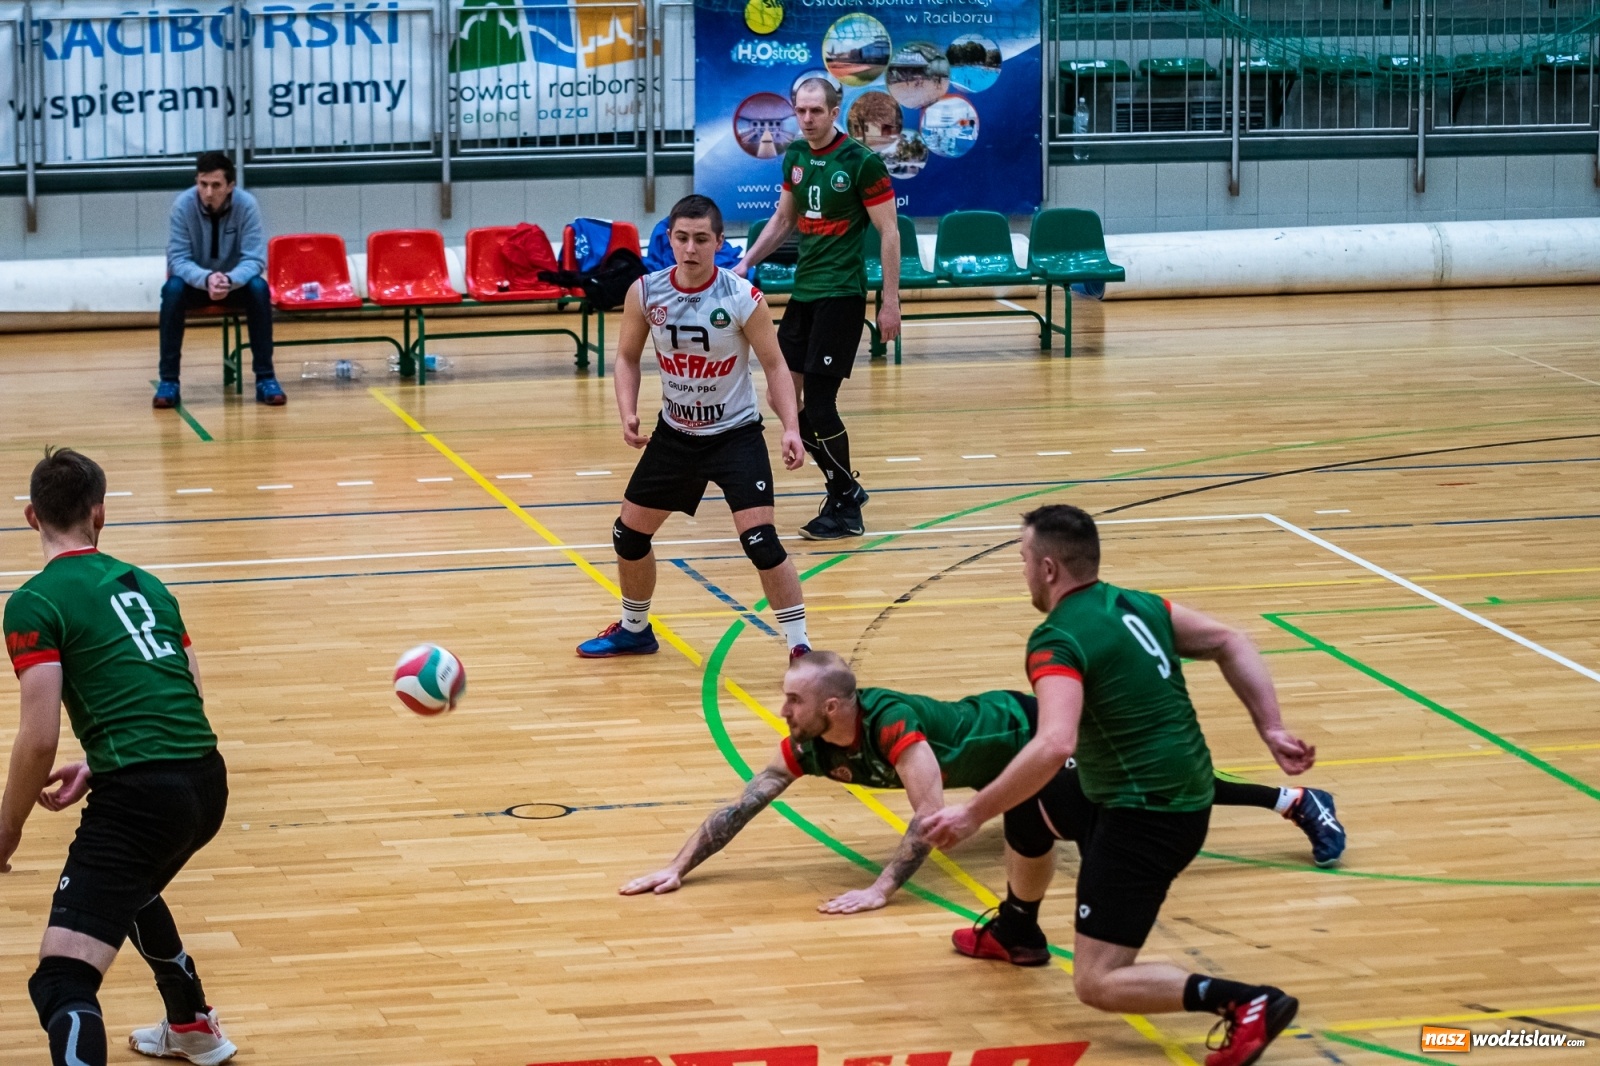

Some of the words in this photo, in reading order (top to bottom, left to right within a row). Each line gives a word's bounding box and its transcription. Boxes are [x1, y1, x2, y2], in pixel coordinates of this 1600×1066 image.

[20, 2, 399, 64] RACIBORSKI
[905, 14, 918, 23] w
[924, 11, 993, 24] Raciborzu
[268, 79, 407, 118] gramy
[808, 185, 821, 211] 13
[665, 324, 710, 352] 17
[668, 380, 694, 393] GRUPA
[697, 385, 717, 393] PBG
[110, 590, 177, 661] 12
[1121, 613, 1171, 680] 9
